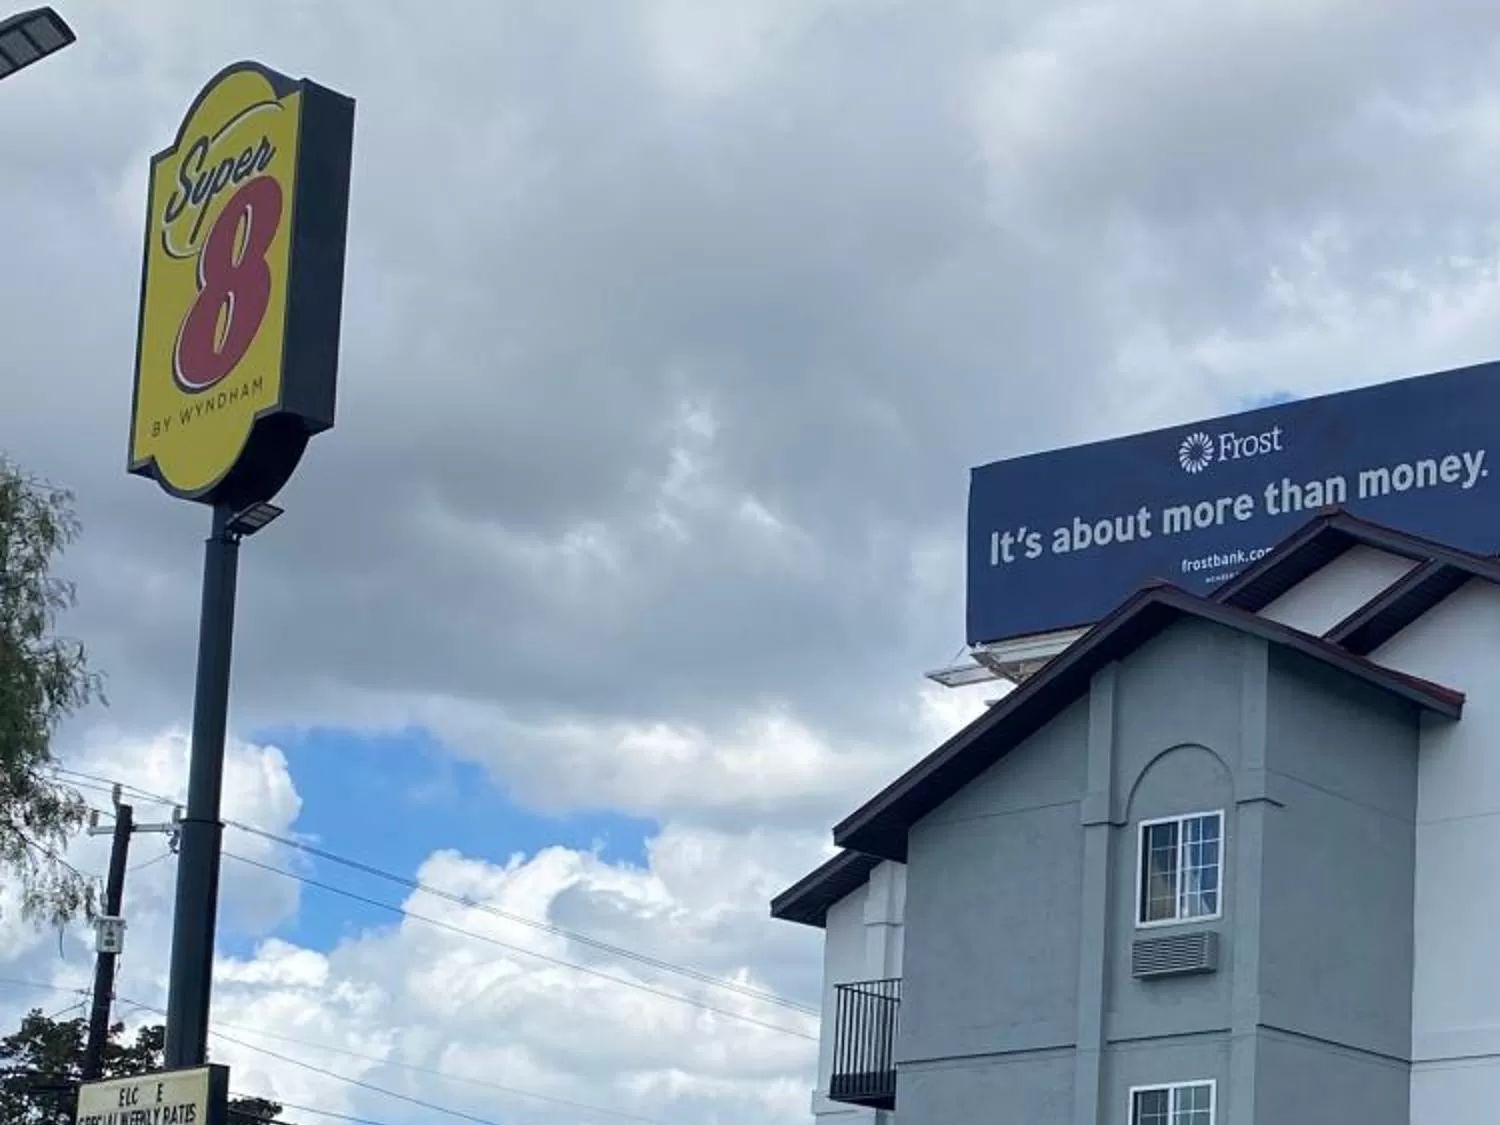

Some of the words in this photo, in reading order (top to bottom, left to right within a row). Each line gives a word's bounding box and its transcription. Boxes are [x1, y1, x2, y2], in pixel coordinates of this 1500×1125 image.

[163, 136, 278, 246] Super
[172, 174, 284, 395] 8
[151, 414, 173, 438] BY
[179, 376, 265, 424] WYNDHAM
[1218, 425, 1284, 464] Frost
[990, 526, 1043, 568] It's
[1052, 510, 1153, 556] about
[1162, 494, 1254, 535] more
[1264, 474, 1348, 515] than
[1358, 448, 1490, 499] money.
